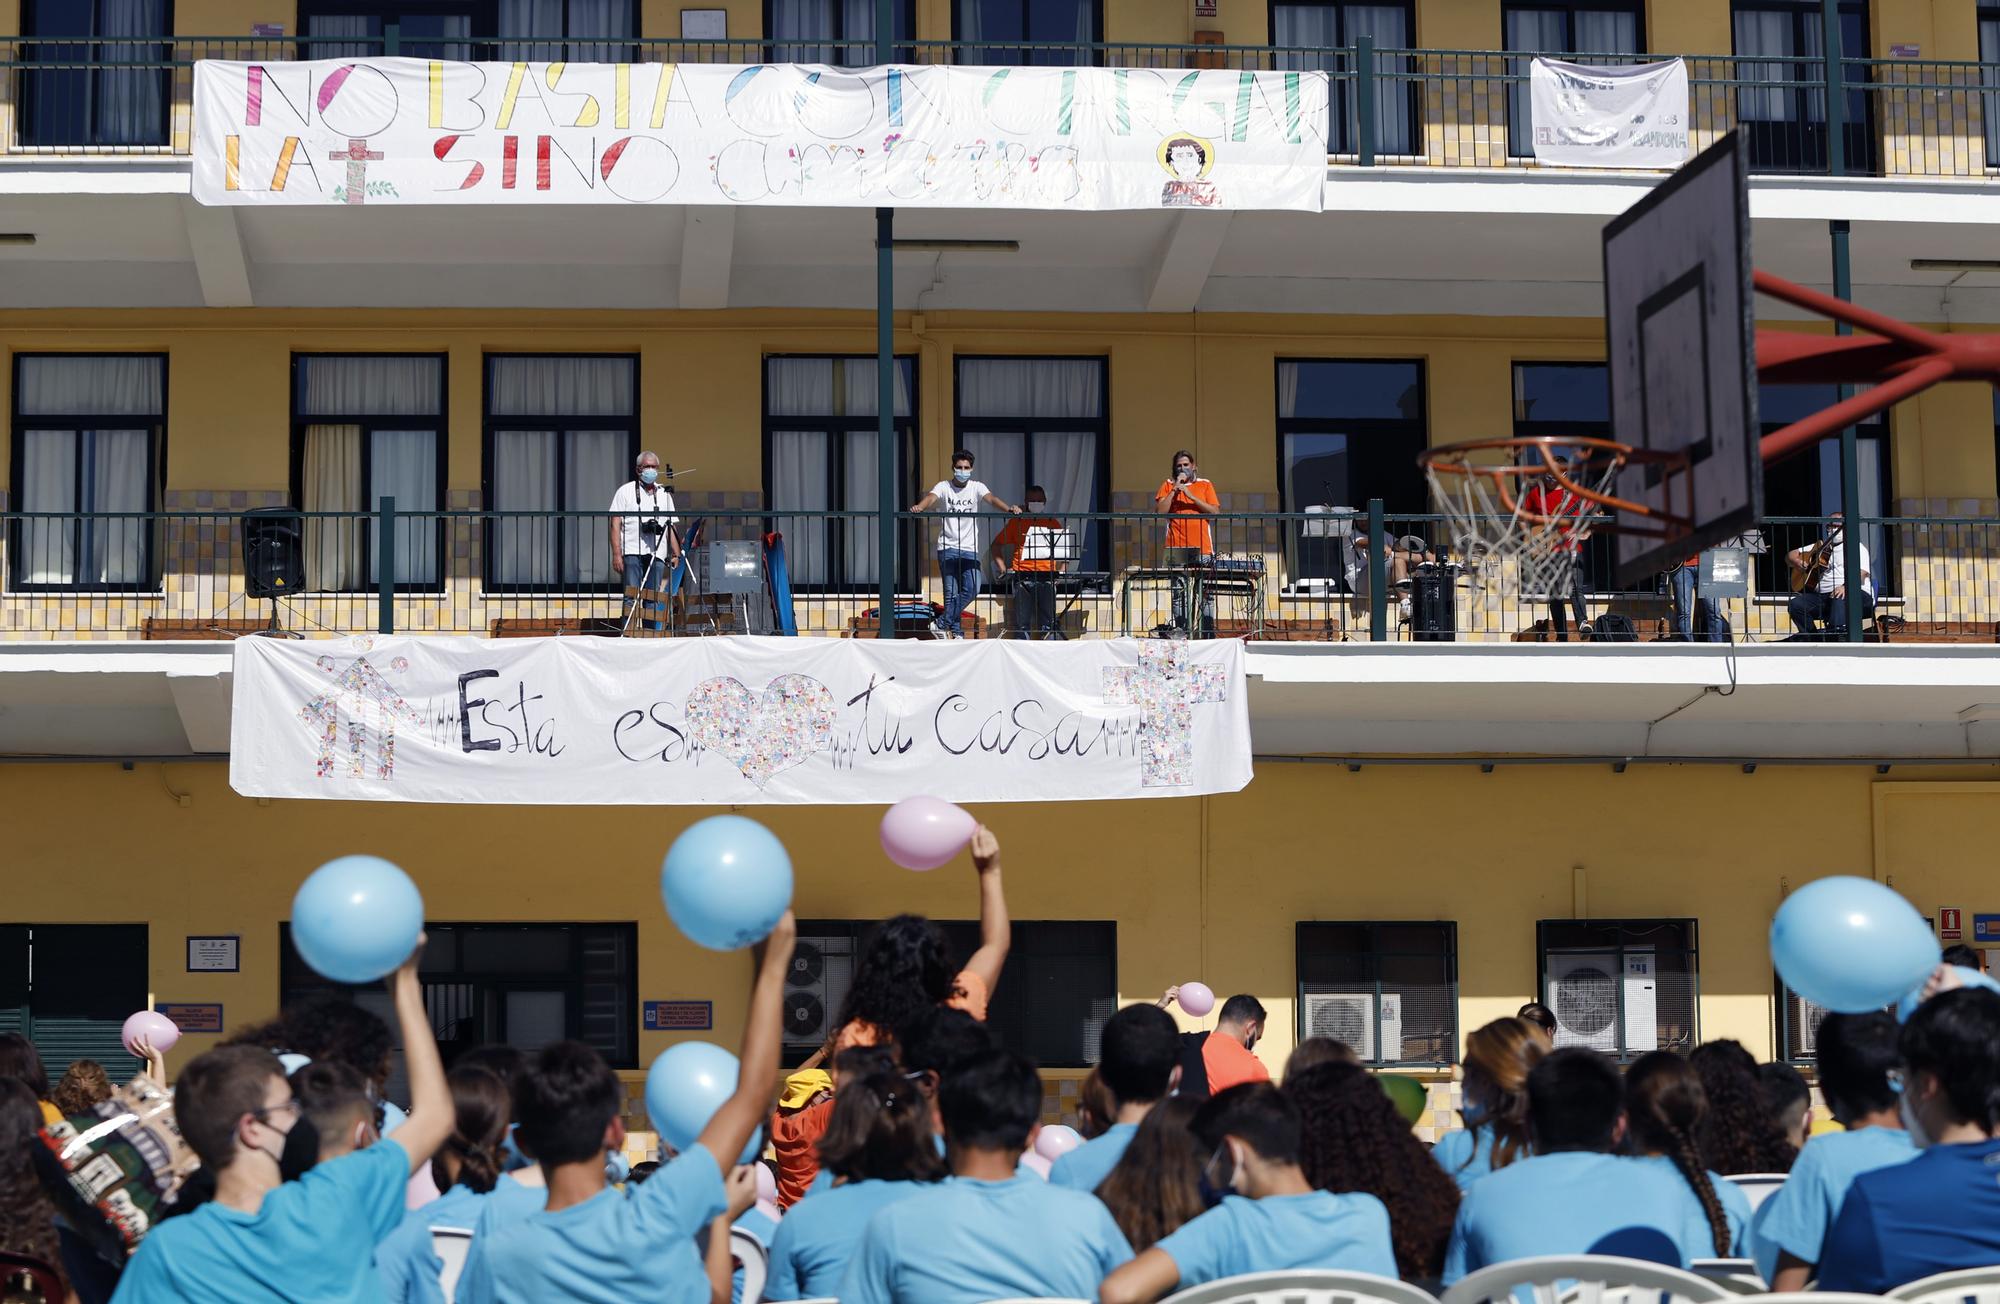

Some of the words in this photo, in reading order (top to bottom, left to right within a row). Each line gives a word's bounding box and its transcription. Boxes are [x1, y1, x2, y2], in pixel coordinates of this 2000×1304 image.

[245, 63, 399, 138] NO
[429, 61, 702, 130] BASTA
[725, 65, 950, 140] CON
[225, 135, 323, 192] LA
[432, 134, 680, 203] SINO
[947, 496, 973, 507] BLACK
[458, 669, 566, 758] Esta
[614, 701, 687, 763] es
[847, 672, 914, 755] tu
